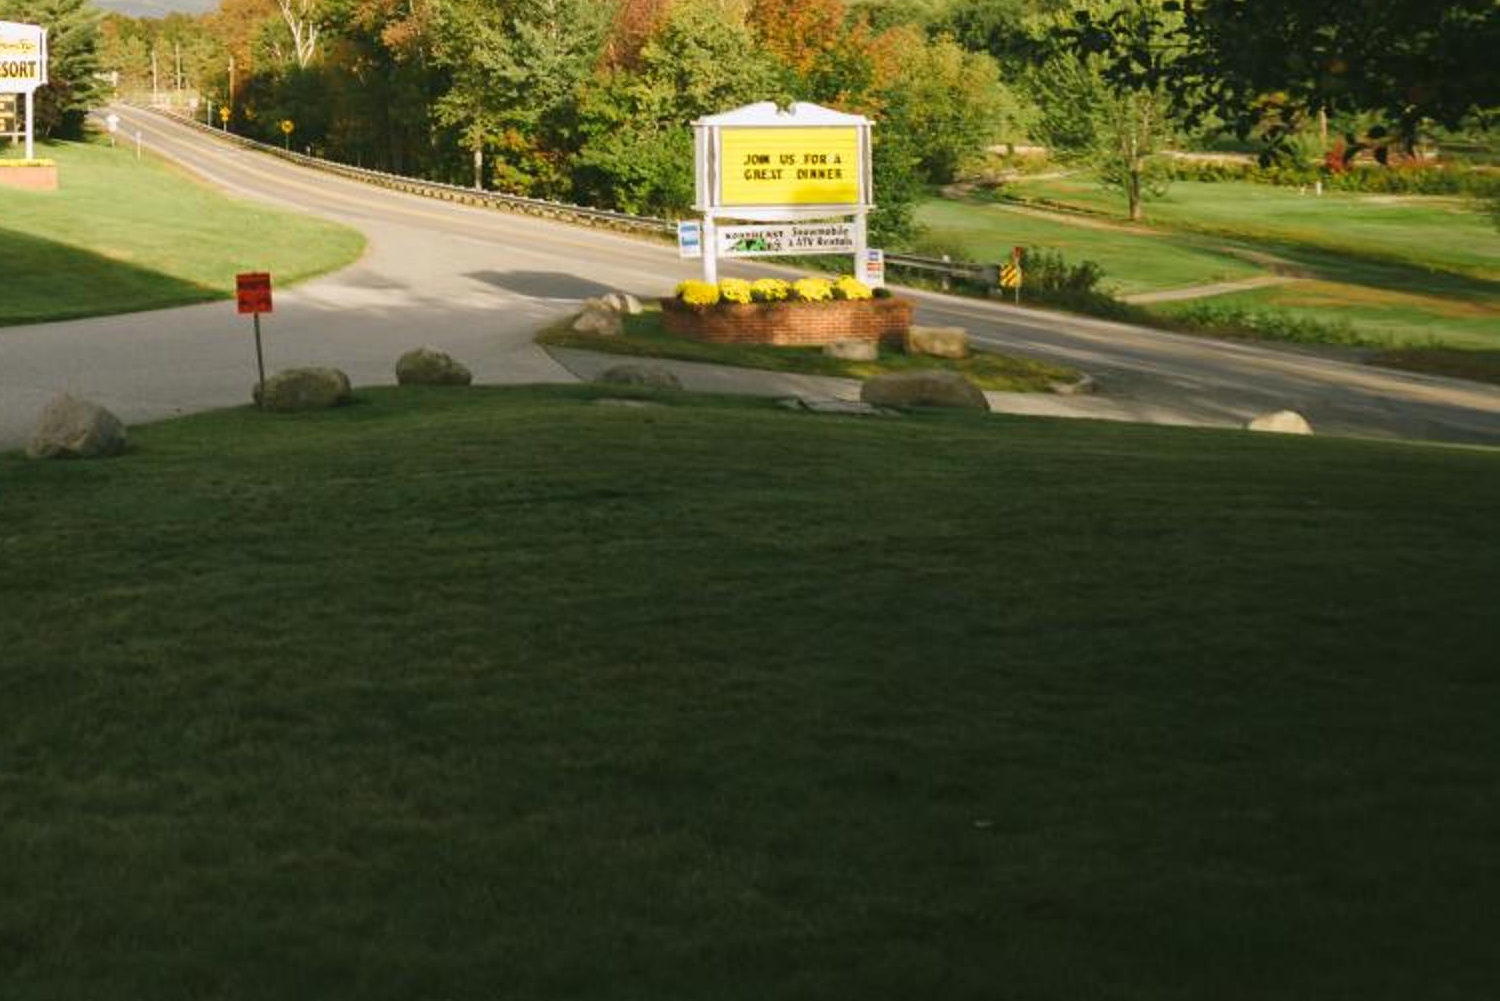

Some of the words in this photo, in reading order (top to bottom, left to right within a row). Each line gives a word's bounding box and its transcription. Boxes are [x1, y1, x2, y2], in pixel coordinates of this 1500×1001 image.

[743, 154, 770, 165] JOIN
[780, 154, 795, 165] US
[803, 154, 827, 165] FOR
[834, 154, 841, 164] A
[743, 168, 782, 180] GREAT
[796, 168, 842, 180] DINNER
[796, 238, 814, 247] ATV
